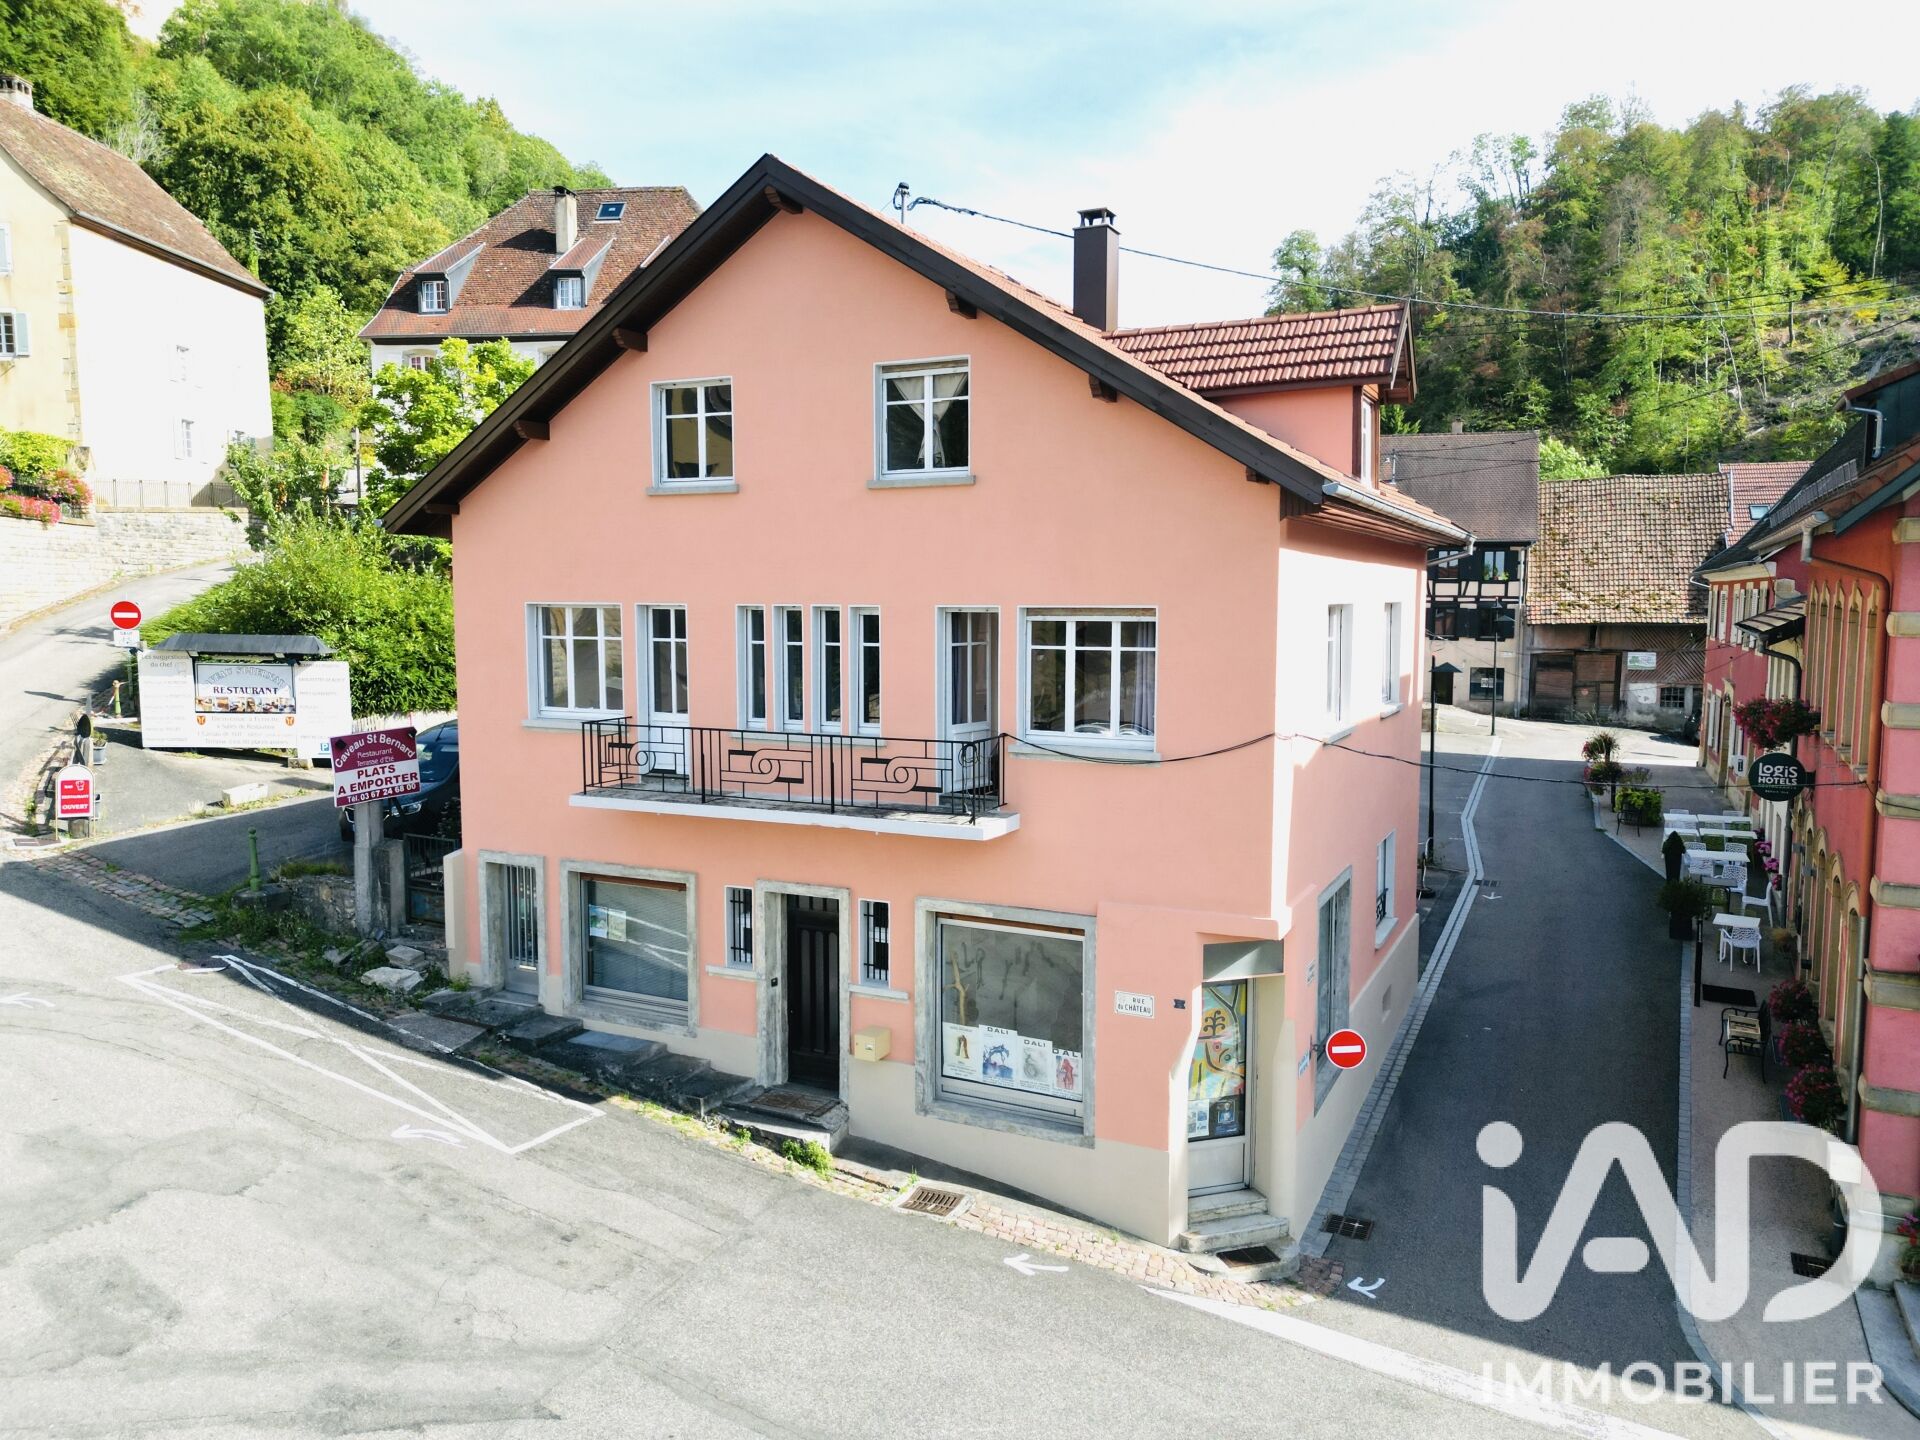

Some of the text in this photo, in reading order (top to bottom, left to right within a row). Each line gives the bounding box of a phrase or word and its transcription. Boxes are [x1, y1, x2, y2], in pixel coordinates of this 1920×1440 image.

[213, 686, 279, 695] RESTAURANT
[335, 733, 415, 768] Caveau St Bernard
[357, 748, 393, 759] Restaurant
[357, 764, 396, 779] PLATS
[338, 772, 418, 796] A EMPORTER
[1758, 776, 1798, 786] HOTELS
[360, 792, 370, 801] 03
[370, 790, 380, 798] 67
[382, 788, 393, 796] 24
[395, 785, 405, 793] 68
[406, 783, 416, 791] 00
[1132, 997, 1145, 1005] RUE
[1124, 1003, 1151, 1014] CHÂTEAU
[987, 1026, 1009, 1035] DALI
[1024, 1039, 1046, 1048] DALI
